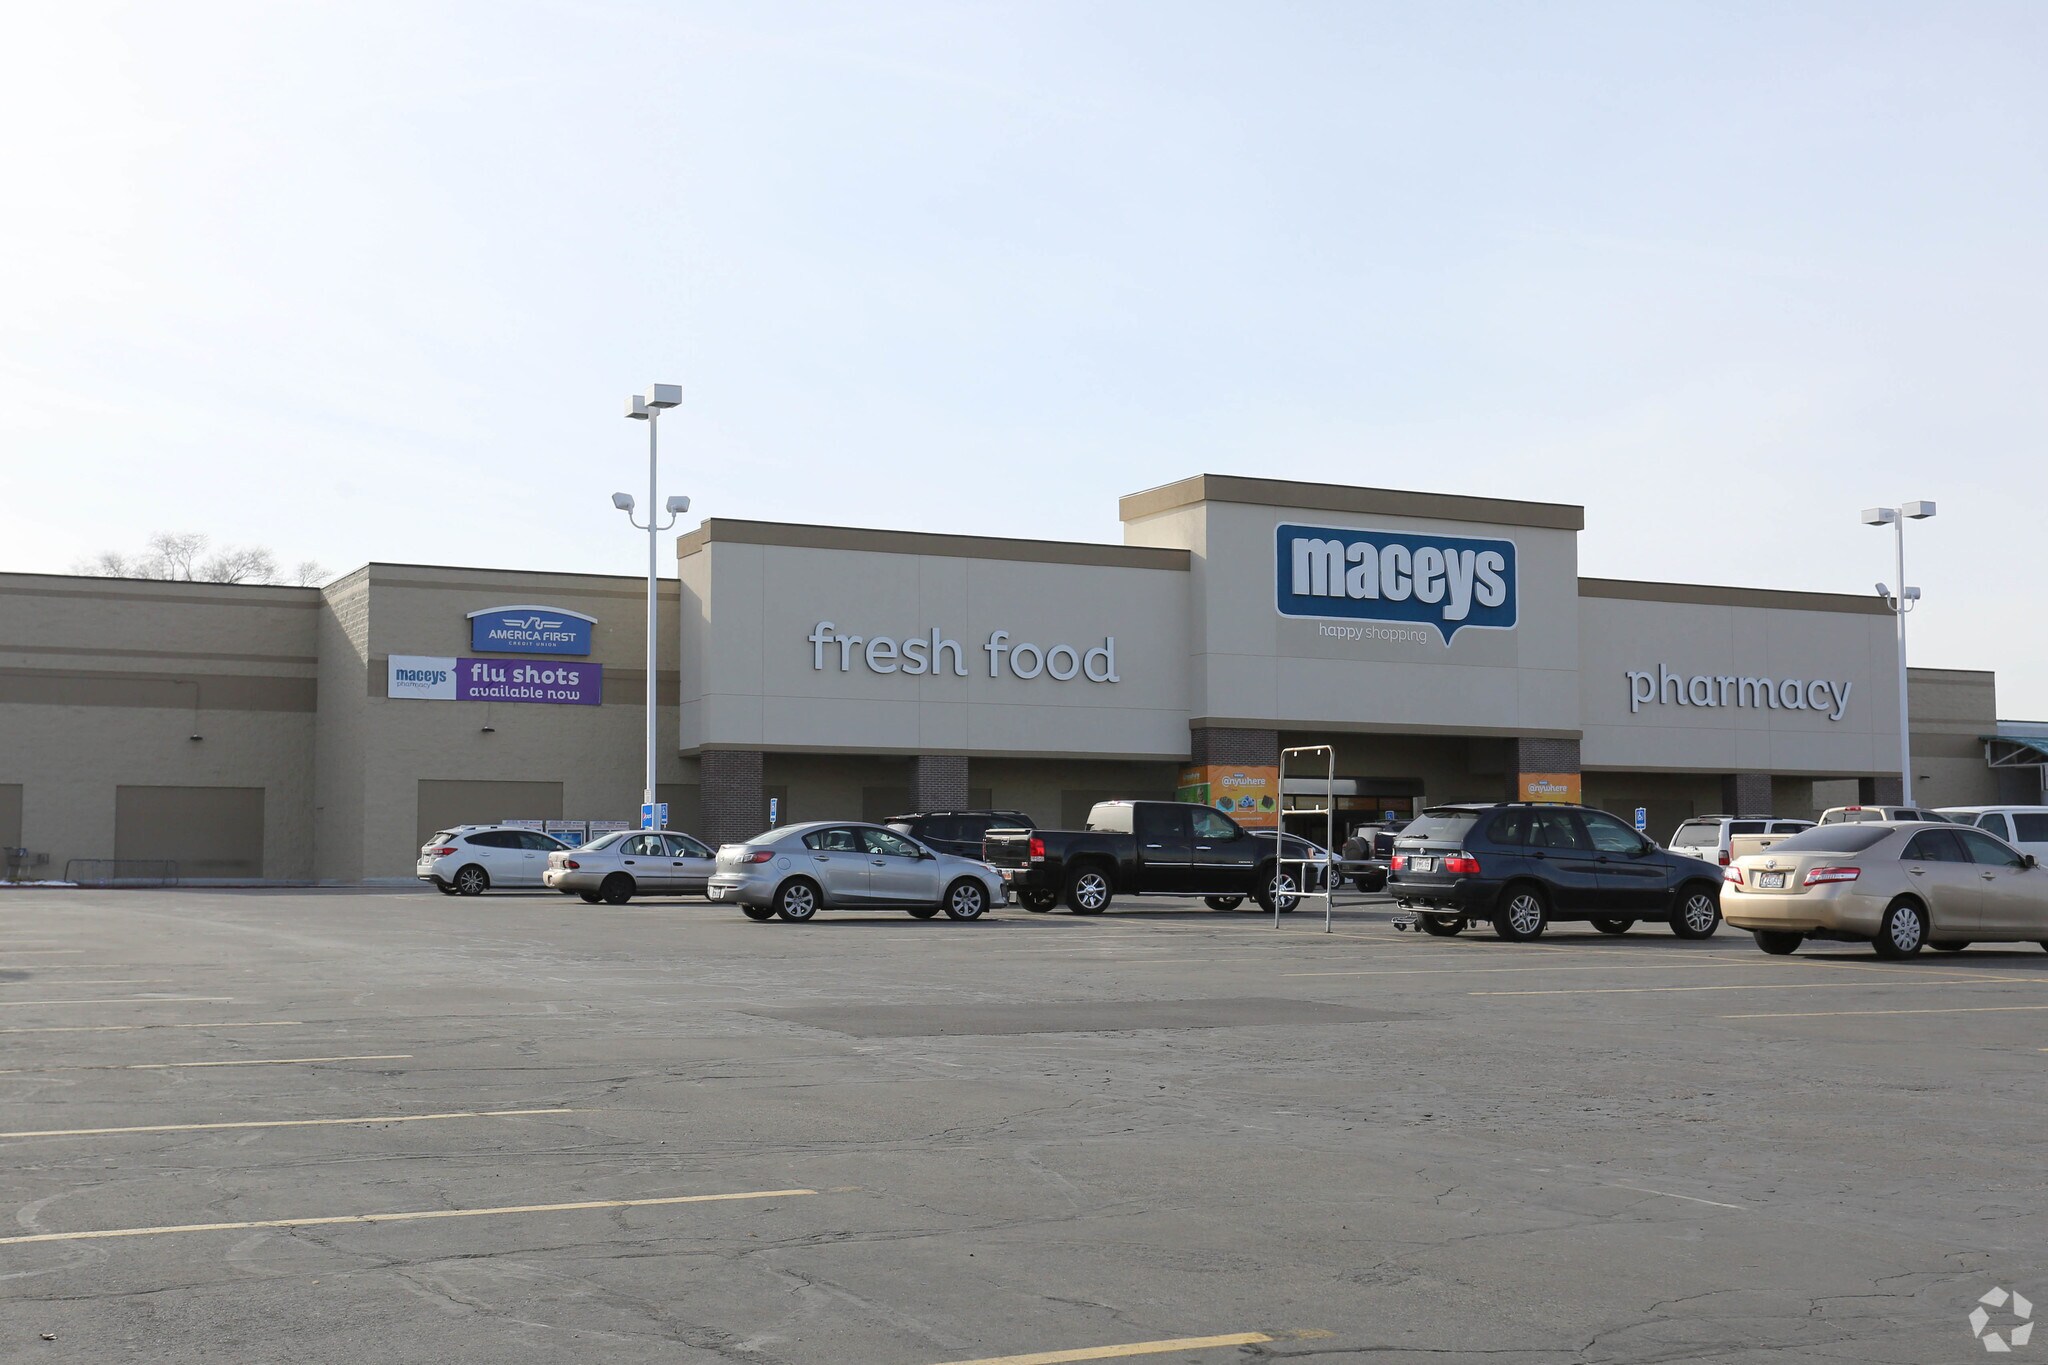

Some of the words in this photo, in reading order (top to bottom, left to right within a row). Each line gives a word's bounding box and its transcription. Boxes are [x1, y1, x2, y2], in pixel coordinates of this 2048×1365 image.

[1291, 538, 1507, 621] maceys
[488, 629, 541, 641] AMERICA
[543, 632, 577, 643] FIRST
[1319, 623, 1363, 641] happy
[1366, 625, 1427, 644] shopping
[808, 620, 969, 677] fresh
[983, 630, 1121, 683] food
[396, 668, 447, 685] maceys
[471, 663, 506, 682] flu
[513, 665, 580, 686] shots
[396, 680, 432, 689] pharmacy
[469, 685, 544, 699] available
[547, 688, 580, 700] now
[1625, 663, 1853, 721] pharmacy
[1222, 776, 1266, 787] @nywhere
